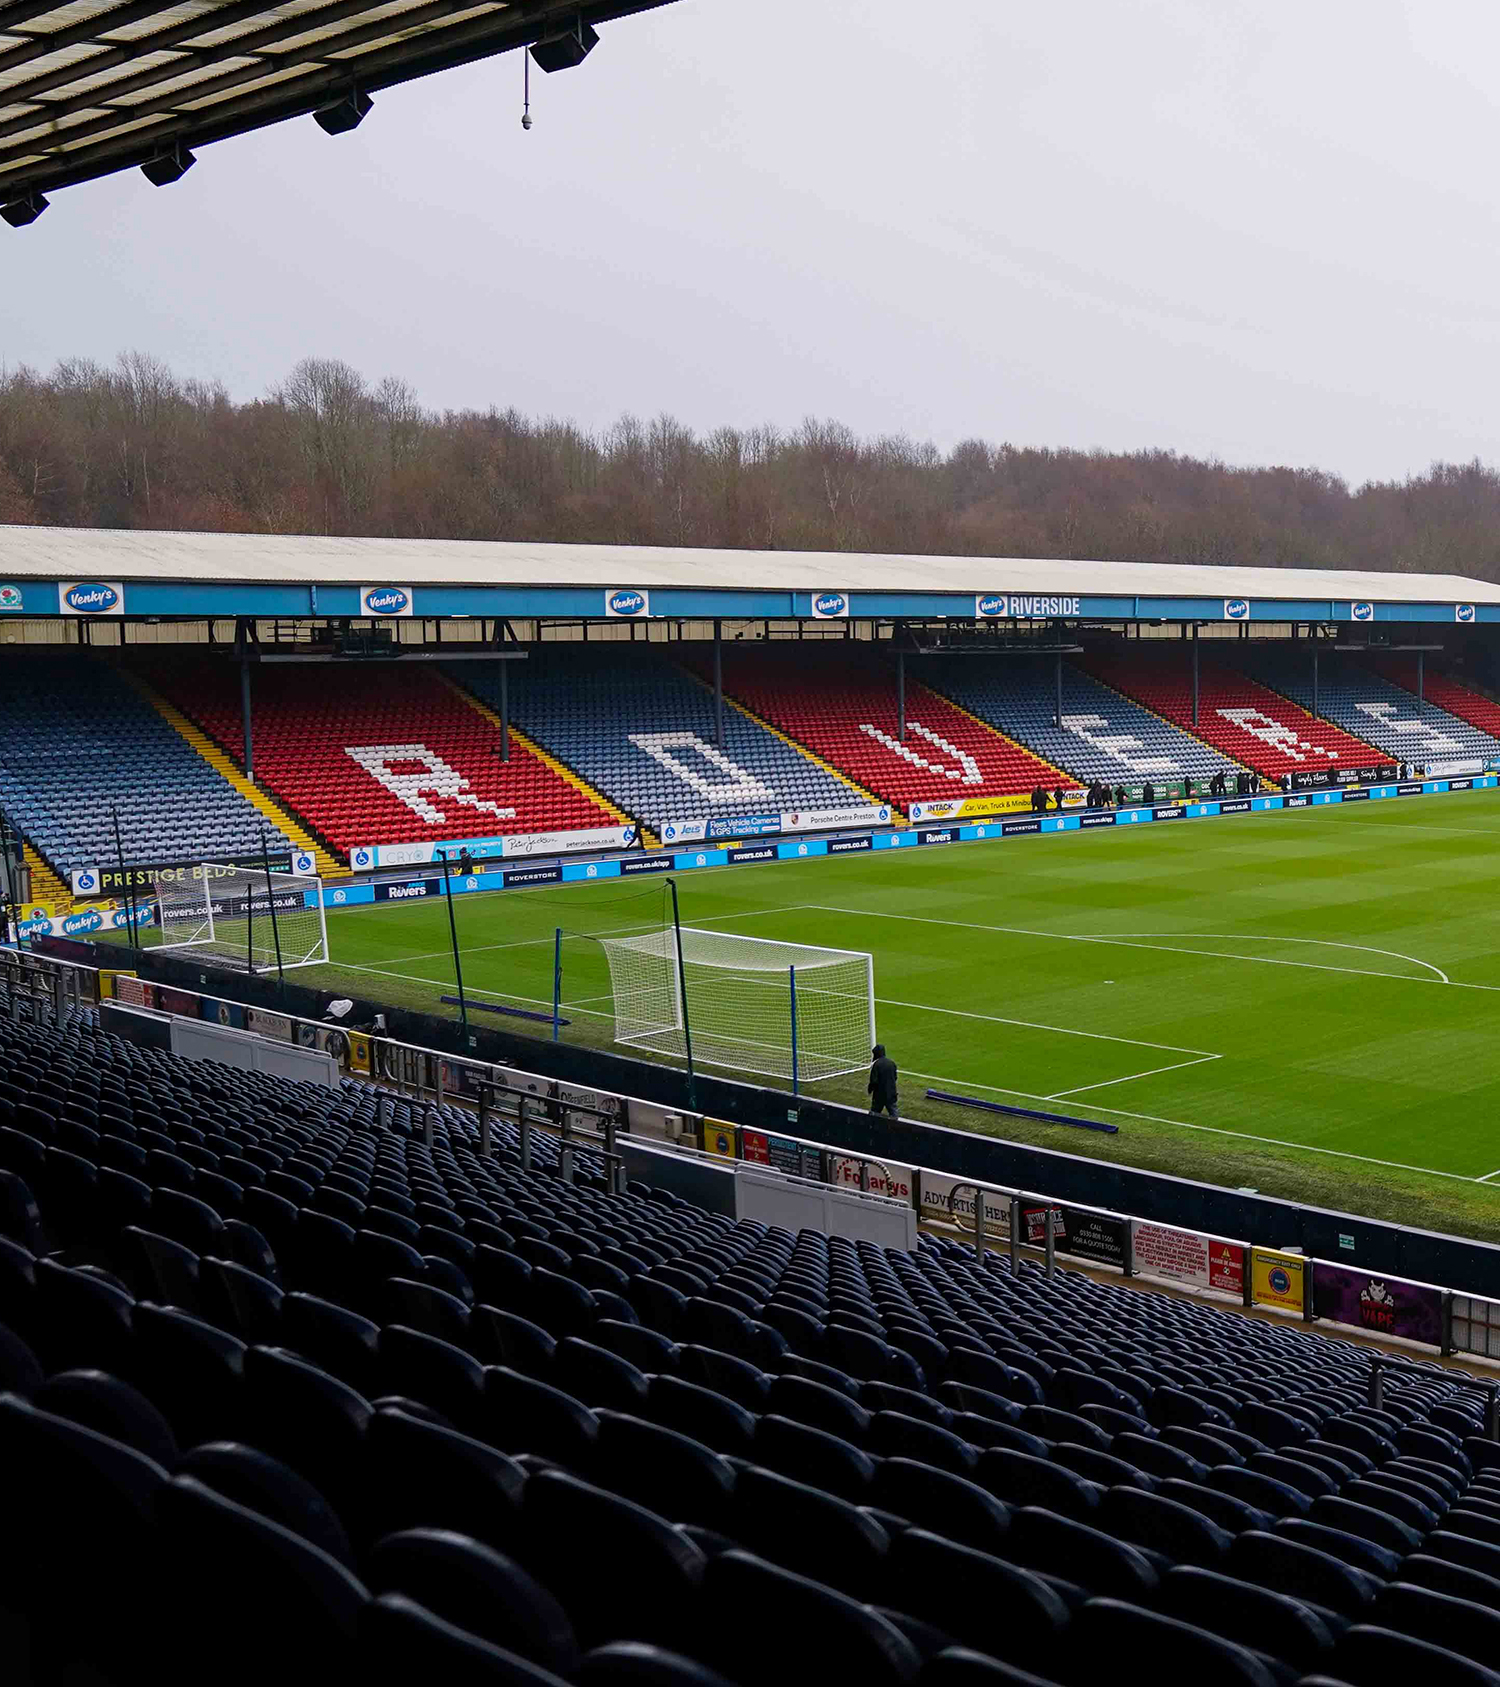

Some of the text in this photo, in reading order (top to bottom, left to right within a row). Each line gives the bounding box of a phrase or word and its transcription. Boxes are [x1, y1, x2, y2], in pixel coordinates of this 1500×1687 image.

[71, 590, 112, 606] Venky's
[370, 594, 403, 608] Venky's
[613, 597, 642, 610] Venky's
[818, 599, 842, 610] Venky's
[980, 600, 1002, 611] Venky's
[1010, 597, 1080, 615] RIVERSIDE
[928, 803, 954, 812] INTACK
[966, 804, 976, 812] Car,
[977, 803, 989, 811] Van,
[990, 802, 1005, 810] Truck
[1289, 798, 1307, 806] Rovers
[710, 816, 780, 828] Fleet Vehicle Cameras
[810, 816, 833, 824] Porsche
[716, 828, 731, 836] GPS
[732, 826, 759, 834] Tracking
[926, 832, 952, 842] Rovers
[566, 838, 616, 849] peterjackson.co.uk
[832, 840, 869, 850] rovers.co.uk
[386, 850, 424, 864] CRYO
[734, 850, 773, 860] rovers.co.uk
[626, 860, 670, 870] rovers.co.uk/app
[102, 864, 236, 888] PRESTIGE BEDS
[508, 872, 557, 882] ROVERSTORE
[388, 886, 426, 898] Rovers
[66, 916, 98, 932] Venky's
[1090, 1223, 1102, 1232] CALL
[1168, 1230, 1198, 1242] THREATENING
[1073, 1236, 1082, 1244] FOR
[1088, 1240, 1105, 1249] QUOTE
[1104, 1243, 1122, 1253] TODAY
[1134, 1234, 1156, 1242] LANGUAGE
[1162, 1240, 1182, 1248] STRICTLY
[1182, 1246, 1207, 1255] FORBIDDEN
[1183, 1240, 1202, 1248] ABUSIVE
[1142, 1248, 1163, 1256] EJECTION
[1164, 1252, 1176, 1260] FROM
[1155, 1244, 1172, 1252] RESULT
[1178, 1250, 1194, 1258] ARREST
[1257, 1256, 1280, 1264] EMERGENCY
